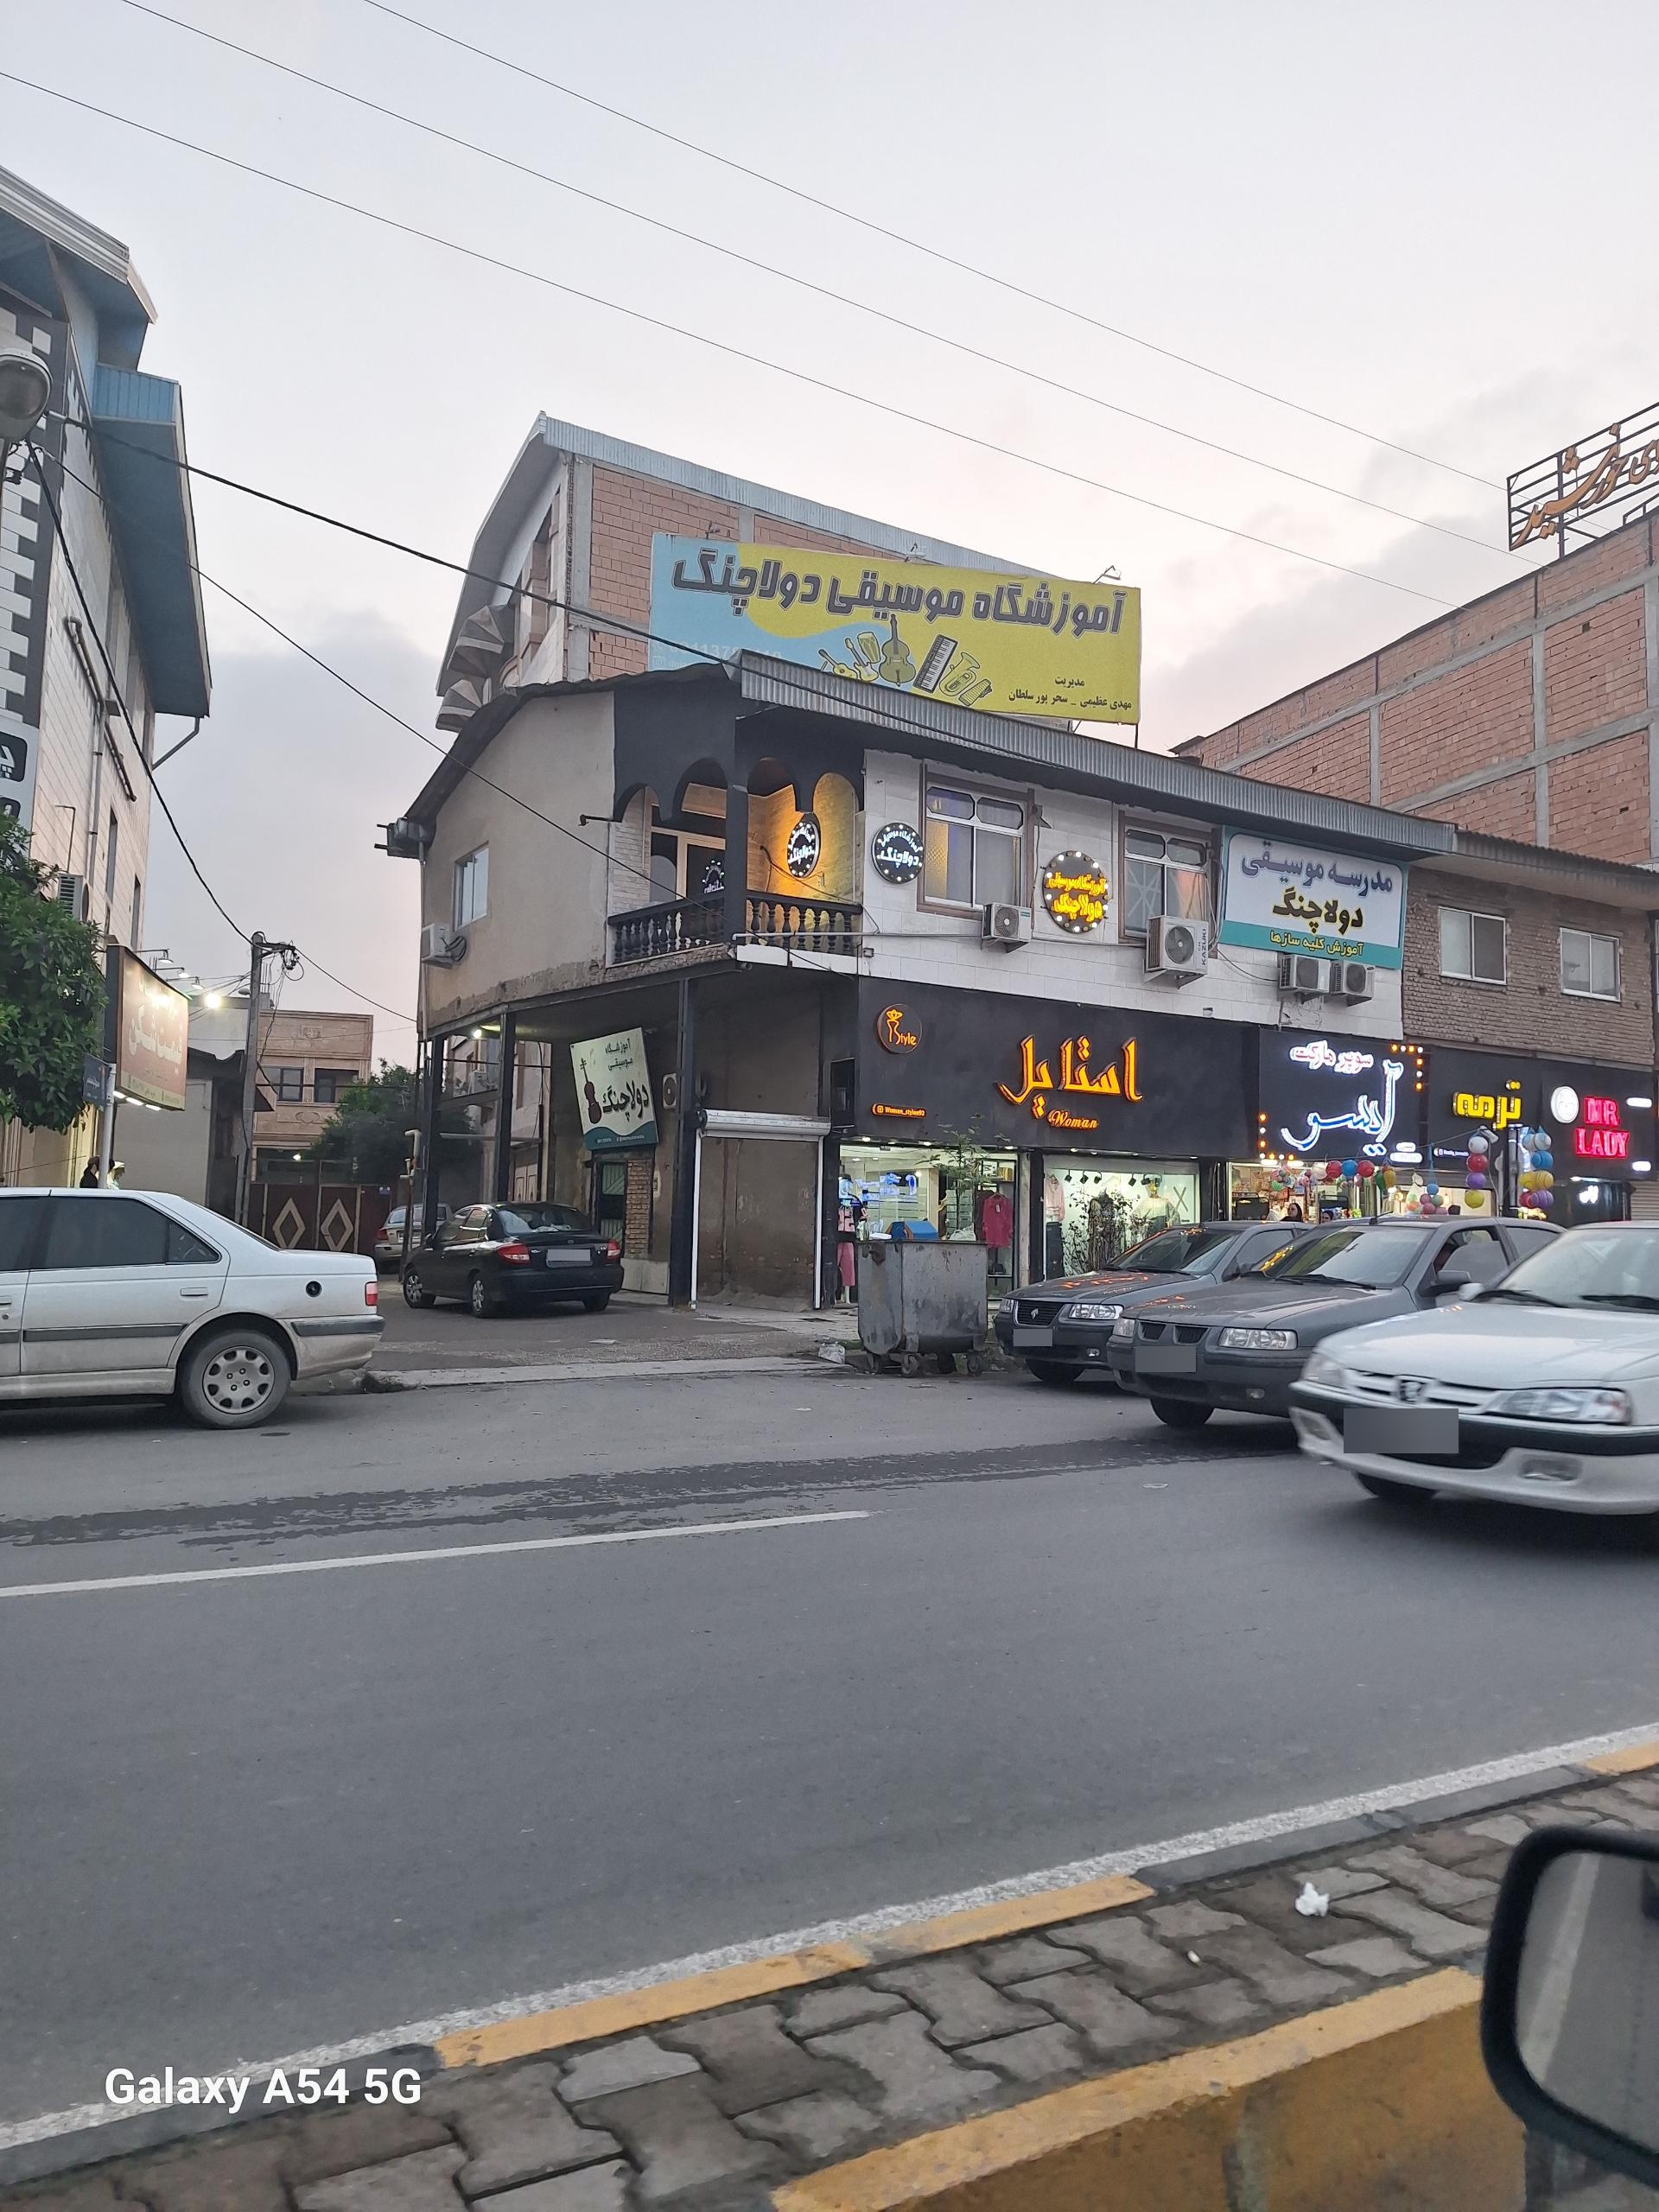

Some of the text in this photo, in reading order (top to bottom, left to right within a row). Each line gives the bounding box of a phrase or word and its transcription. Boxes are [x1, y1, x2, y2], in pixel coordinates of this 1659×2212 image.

[671, 547, 1128, 638] آموزشگاه موسیقی دولاچنگ
[1008, 689, 1034, 702] سلطان
[1054, 677, 1085, 689] مدیریت
[1035, 692, 1048, 705] پور
[1051, 693, 1068, 705] سحر
[1080, 696, 1108, 709] عظیمی
[1109, 698, 1132, 710] مهدی
[880, 846, 920, 868] دولاچنگ
[1241, 841, 1394, 897] مدرسه موسیقی
[1051, 892, 1103, 923] دولاچنگ
[1271, 886, 1364, 936] دولاچنگ
[1270, 930, 1364, 957] آموزش کلیه سازها
[605, 1038, 632, 1055] آموزشگاه
[1289, 1039, 1374, 1074] سوپر مارکت
[607, 1057, 634, 1071] موسیقی
[996, 1034, 1144, 1119] استایل
[602, 1079, 650, 1122] دولاچنگ
[1452, 1079, 1522, 1131] ترمه
[1583, 1096, 1621, 1127] MR
[1048, 1109, 1100, 1129] Woman
[1575, 1126, 1630, 1159] LADY
